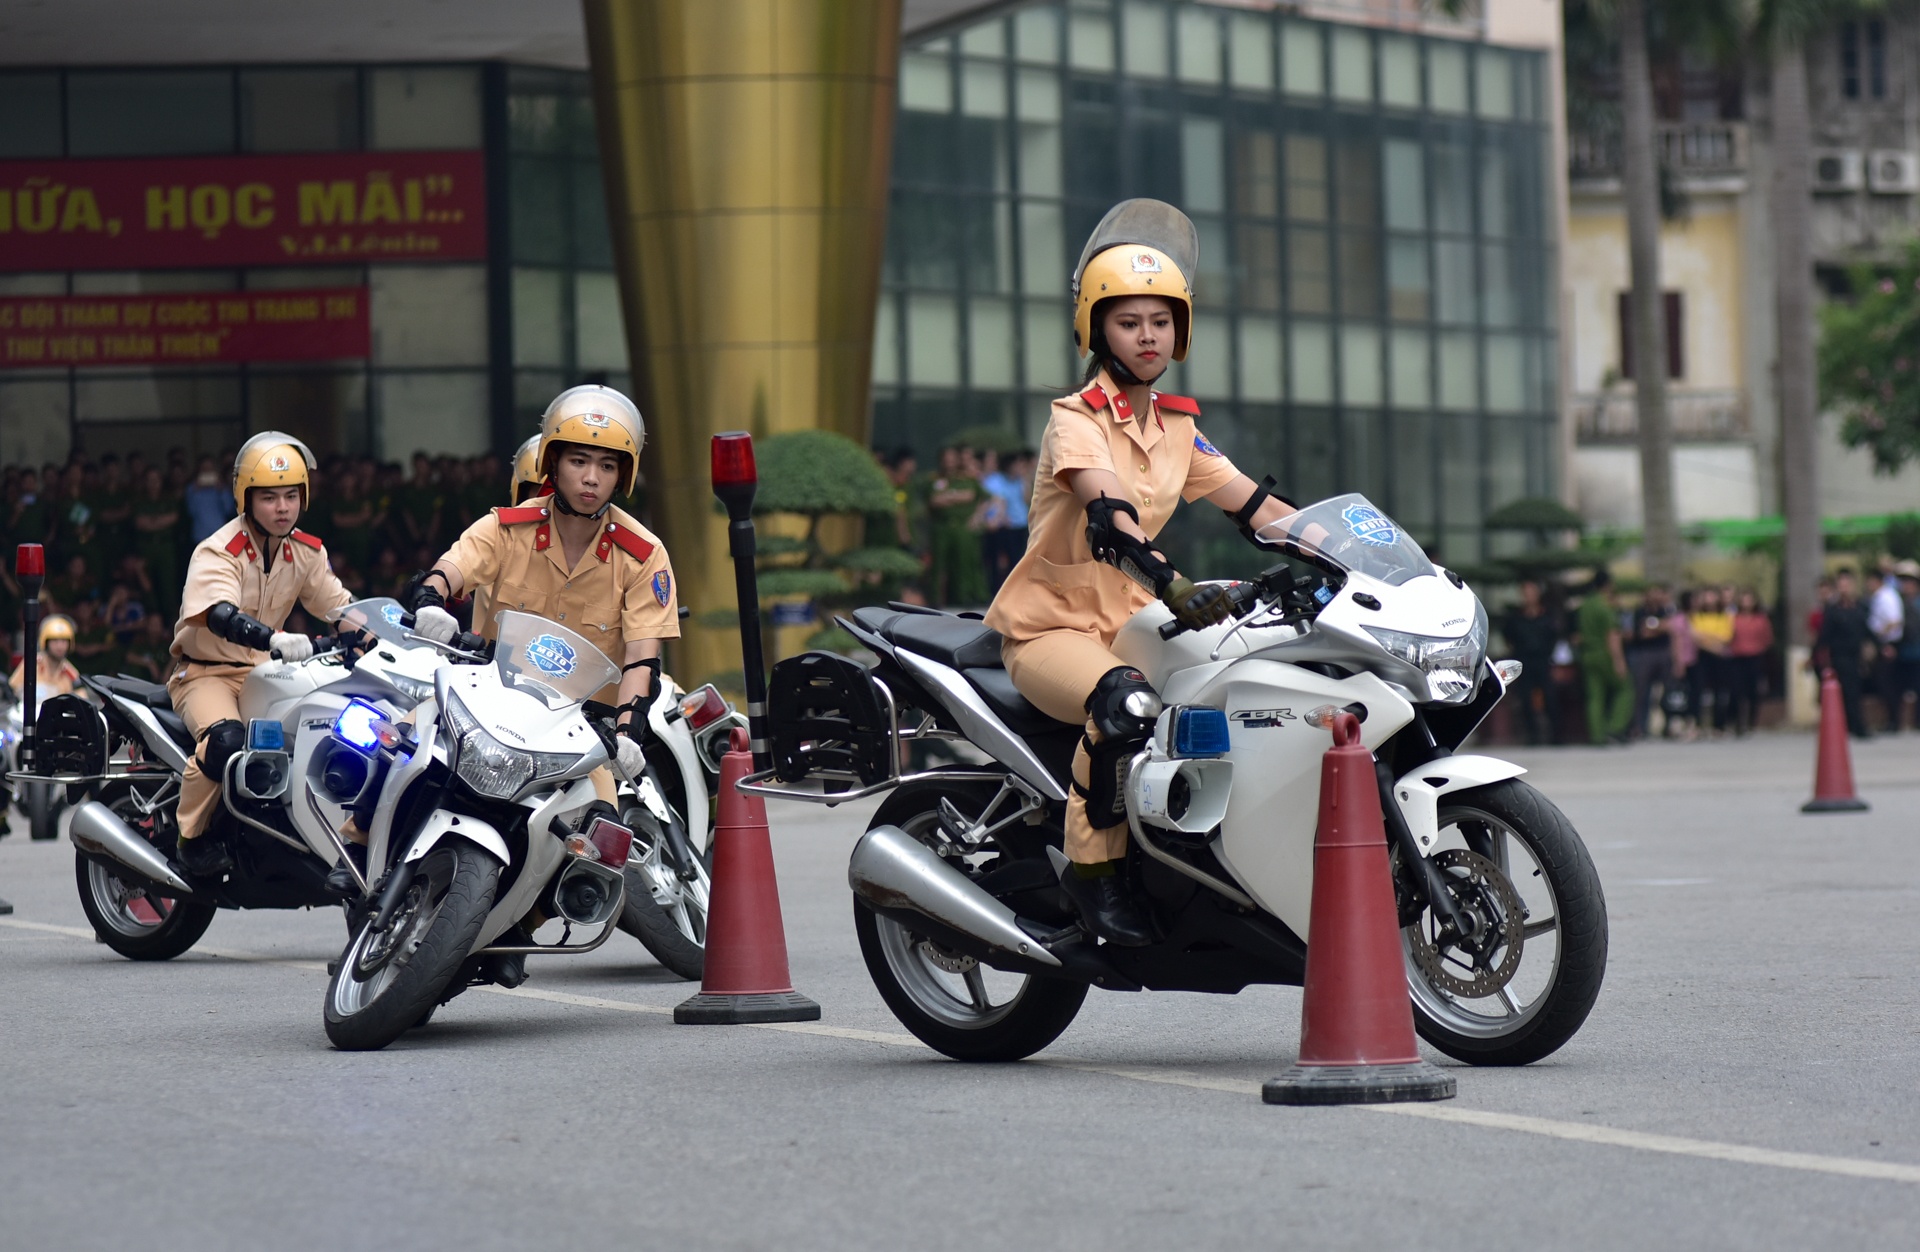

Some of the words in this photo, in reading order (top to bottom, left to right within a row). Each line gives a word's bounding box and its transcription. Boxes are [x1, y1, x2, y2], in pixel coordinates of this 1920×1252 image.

[145, 183, 274, 239] HỌC
[1358, 519, 1388, 533] MOTO
[1441, 617, 1468, 628] HONDA
[536, 646, 567, 666] MOTO
[539, 658, 554, 670] CLUB
[264, 672, 295, 681] HONDA
[1229, 708, 1297, 721] CBR
[495, 724, 527, 744] HONDA
